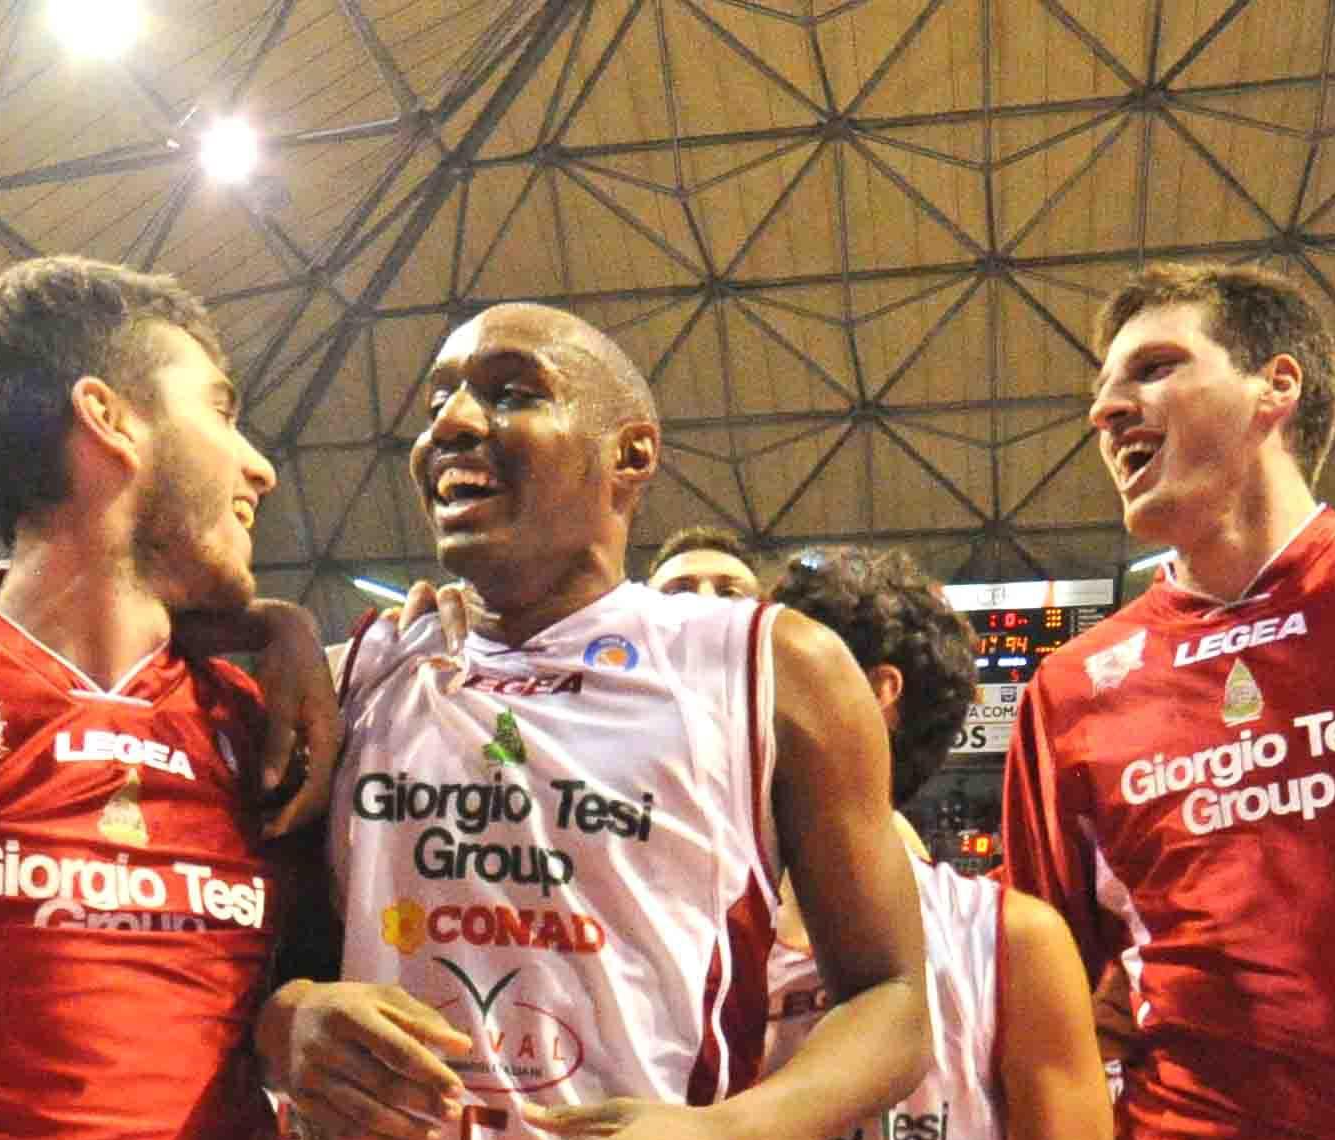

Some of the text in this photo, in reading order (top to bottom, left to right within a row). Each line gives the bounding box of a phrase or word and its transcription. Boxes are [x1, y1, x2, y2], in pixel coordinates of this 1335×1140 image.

[1172, 612, 1309, 668] LEGEA
[53, 729, 196, 781] LEGEA
[1120, 729, 1288, 805] Giorgio
[353, 772, 655, 843] Giorgio Tesi
[173, 861, 266, 929] Tesi
[414, 826, 578, 897] Group
[426, 904, 605, 954] CONAD
